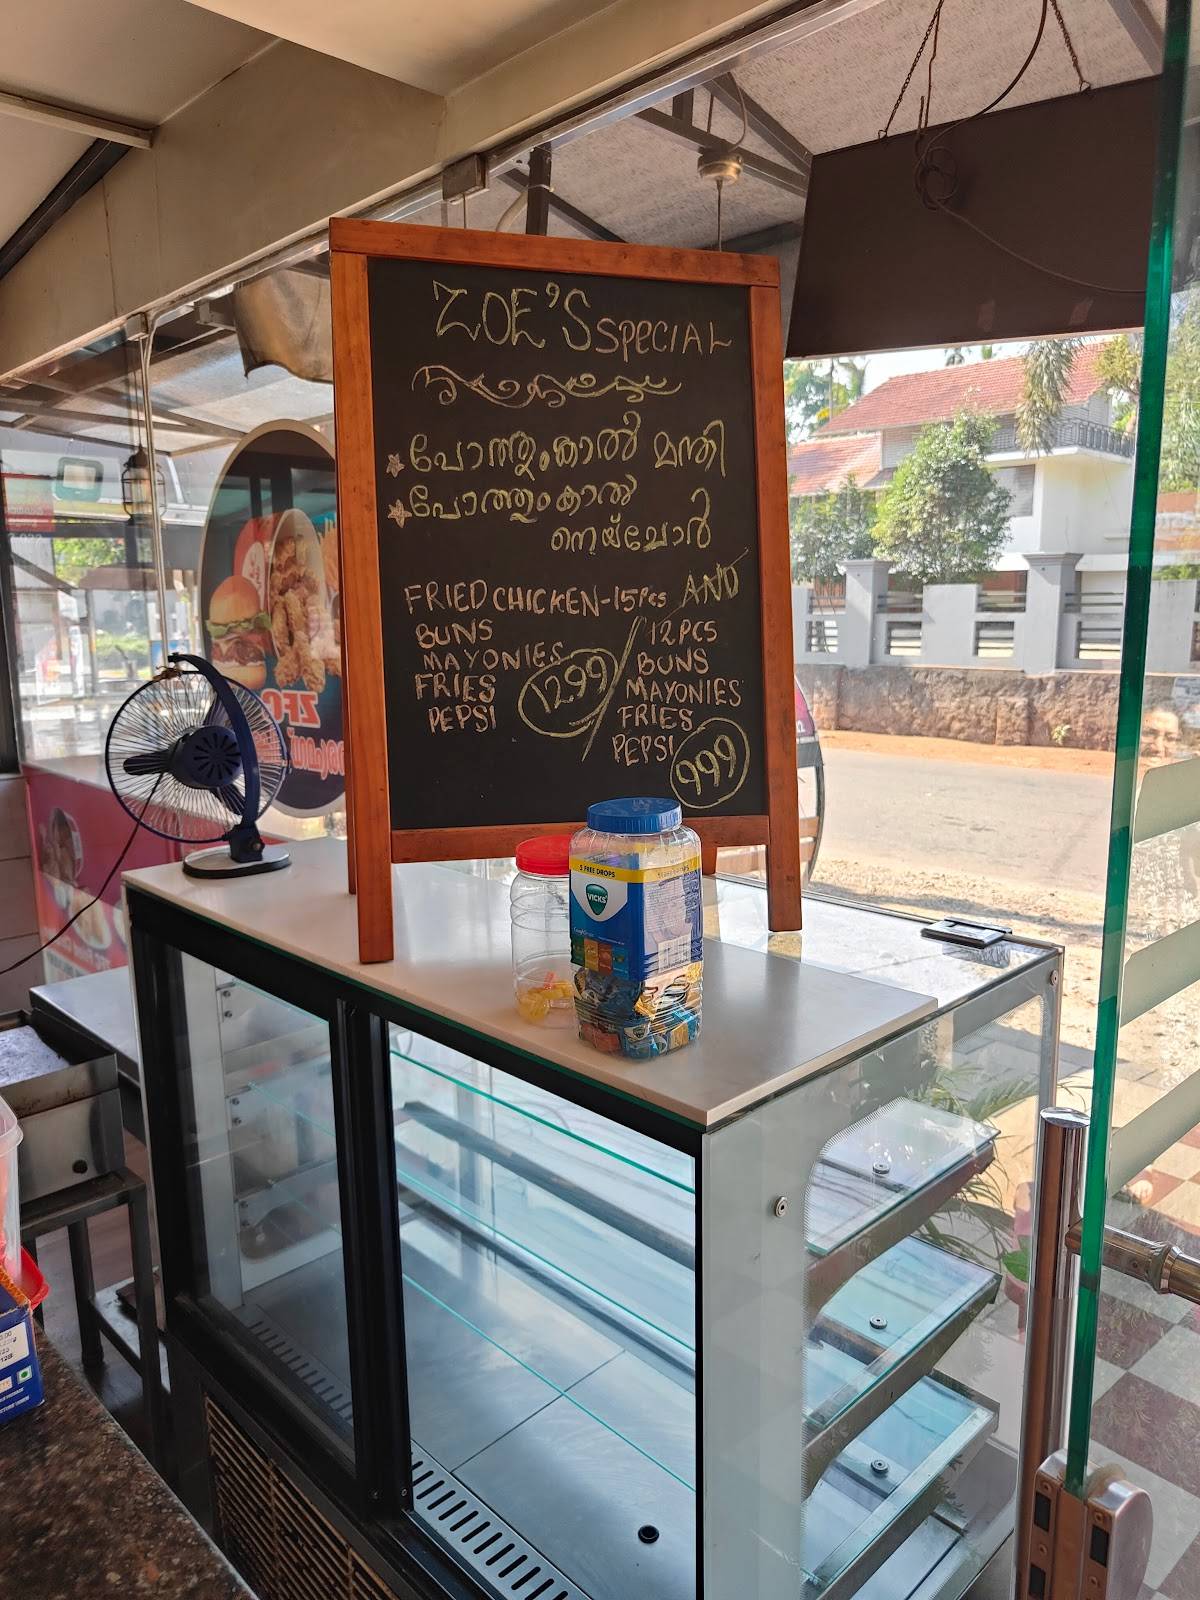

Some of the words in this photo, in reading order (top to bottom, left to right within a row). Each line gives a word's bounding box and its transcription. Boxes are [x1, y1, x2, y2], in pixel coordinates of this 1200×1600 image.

[404, 579, 488, 615] FRIED
[415, 618, 493, 649] BUNS
[423, 641, 564, 672] MAYONIES
[637, 647, 709, 676] BUNS
[415, 672, 496, 703] FRIES
[626, 676, 742, 707] MAYONIES
[427, 704, 497, 735] PEPSI
[617, 703, 694, 732] FRIES
[612, 733, 674, 767] PEPSI
[675, 734, 738, 796] 999
[583, 865, 596, 875] FREE
[596, 867, 616, 878] DROPS
[587, 892, 607, 904] VICKS
